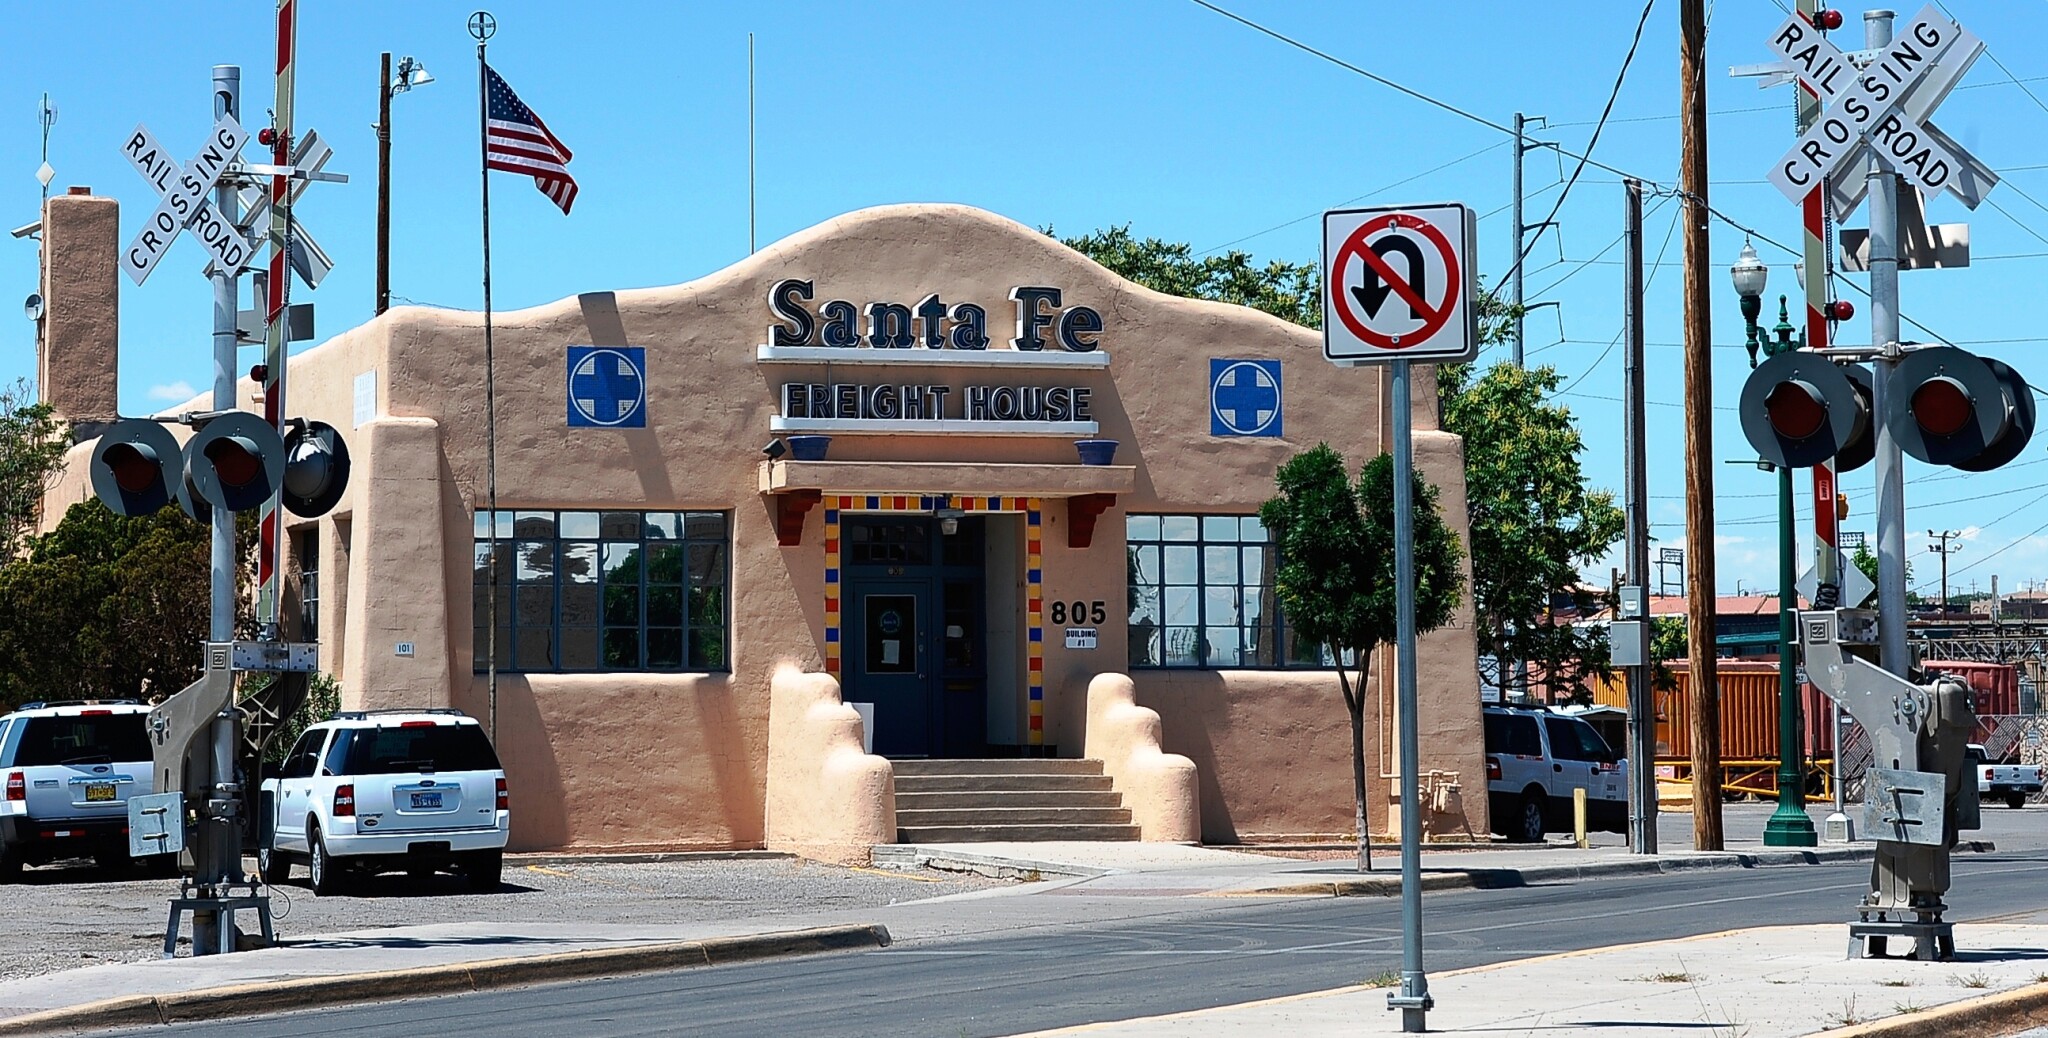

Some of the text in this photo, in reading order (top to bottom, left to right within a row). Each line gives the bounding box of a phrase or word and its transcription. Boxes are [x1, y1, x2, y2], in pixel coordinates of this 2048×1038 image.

[1775, 22, 1842, 96] RAIL
[1784, 22, 1941, 187] CROSSING
[126, 131, 172, 193] RAIL
[1872, 113, 1949, 188] ROAD
[130, 128, 236, 270] CROSSING
[191, 206, 243, 267] ROAD
[768, 278, 1104, 352] Santa Fe
[782, 382, 1092, 422] FREIGHT HOUSE
[1051, 601, 1106, 625] 805
[1066, 630, 1096, 638] BUILDING
[1077, 639, 1085, 647] #1
[398, 643, 410, 653] 101
